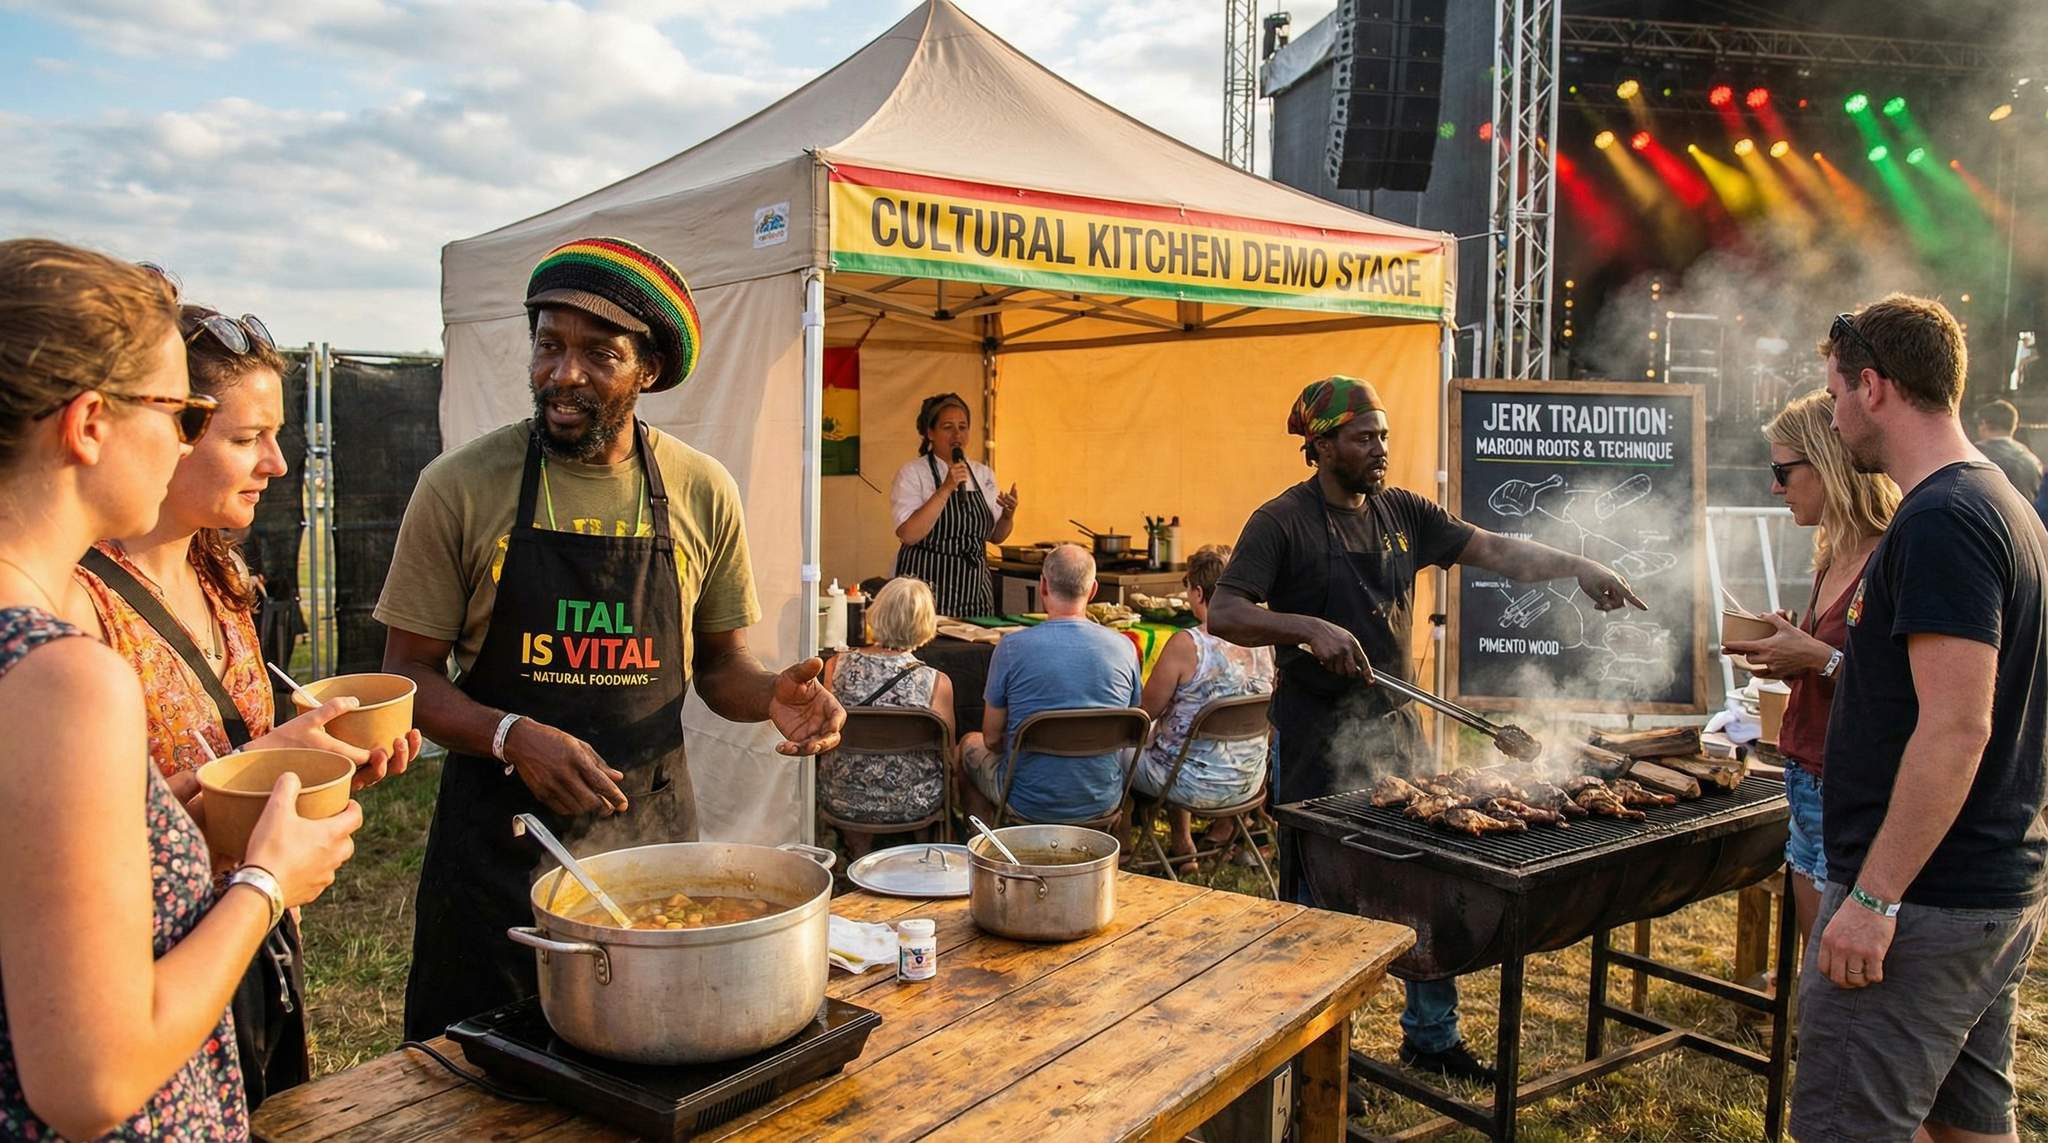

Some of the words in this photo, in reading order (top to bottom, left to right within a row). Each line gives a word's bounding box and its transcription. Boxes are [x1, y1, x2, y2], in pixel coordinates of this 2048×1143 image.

[872, 197, 1076, 265] CULTURAL
[1088, 222, 1231, 279] KITCHEN
[1242, 240, 1328, 288] DEMO
[1335, 251, 1421, 297] STAGE
[1482, 403, 1542, 432] JERK
[1548, 405, 1674, 435] TRADITION:
[1476, 437, 1533, 456] MAROON
[1537, 439, 1579, 457] ROOTS
[1583, 441, 1595, 457] &
[1599, 441, 1673, 461] TECHNIQUE
[556, 599, 633, 634] ITAL
[521, 632, 553, 666] IS
[563, 636, 660, 669] VITAL
[1479, 637, 1526, 654] PIMENTO
[1529, 639, 1559, 655] WOOD
[533, 671, 586, 685] NATURAL
[589, 673, 649, 685] FOODWAYS
